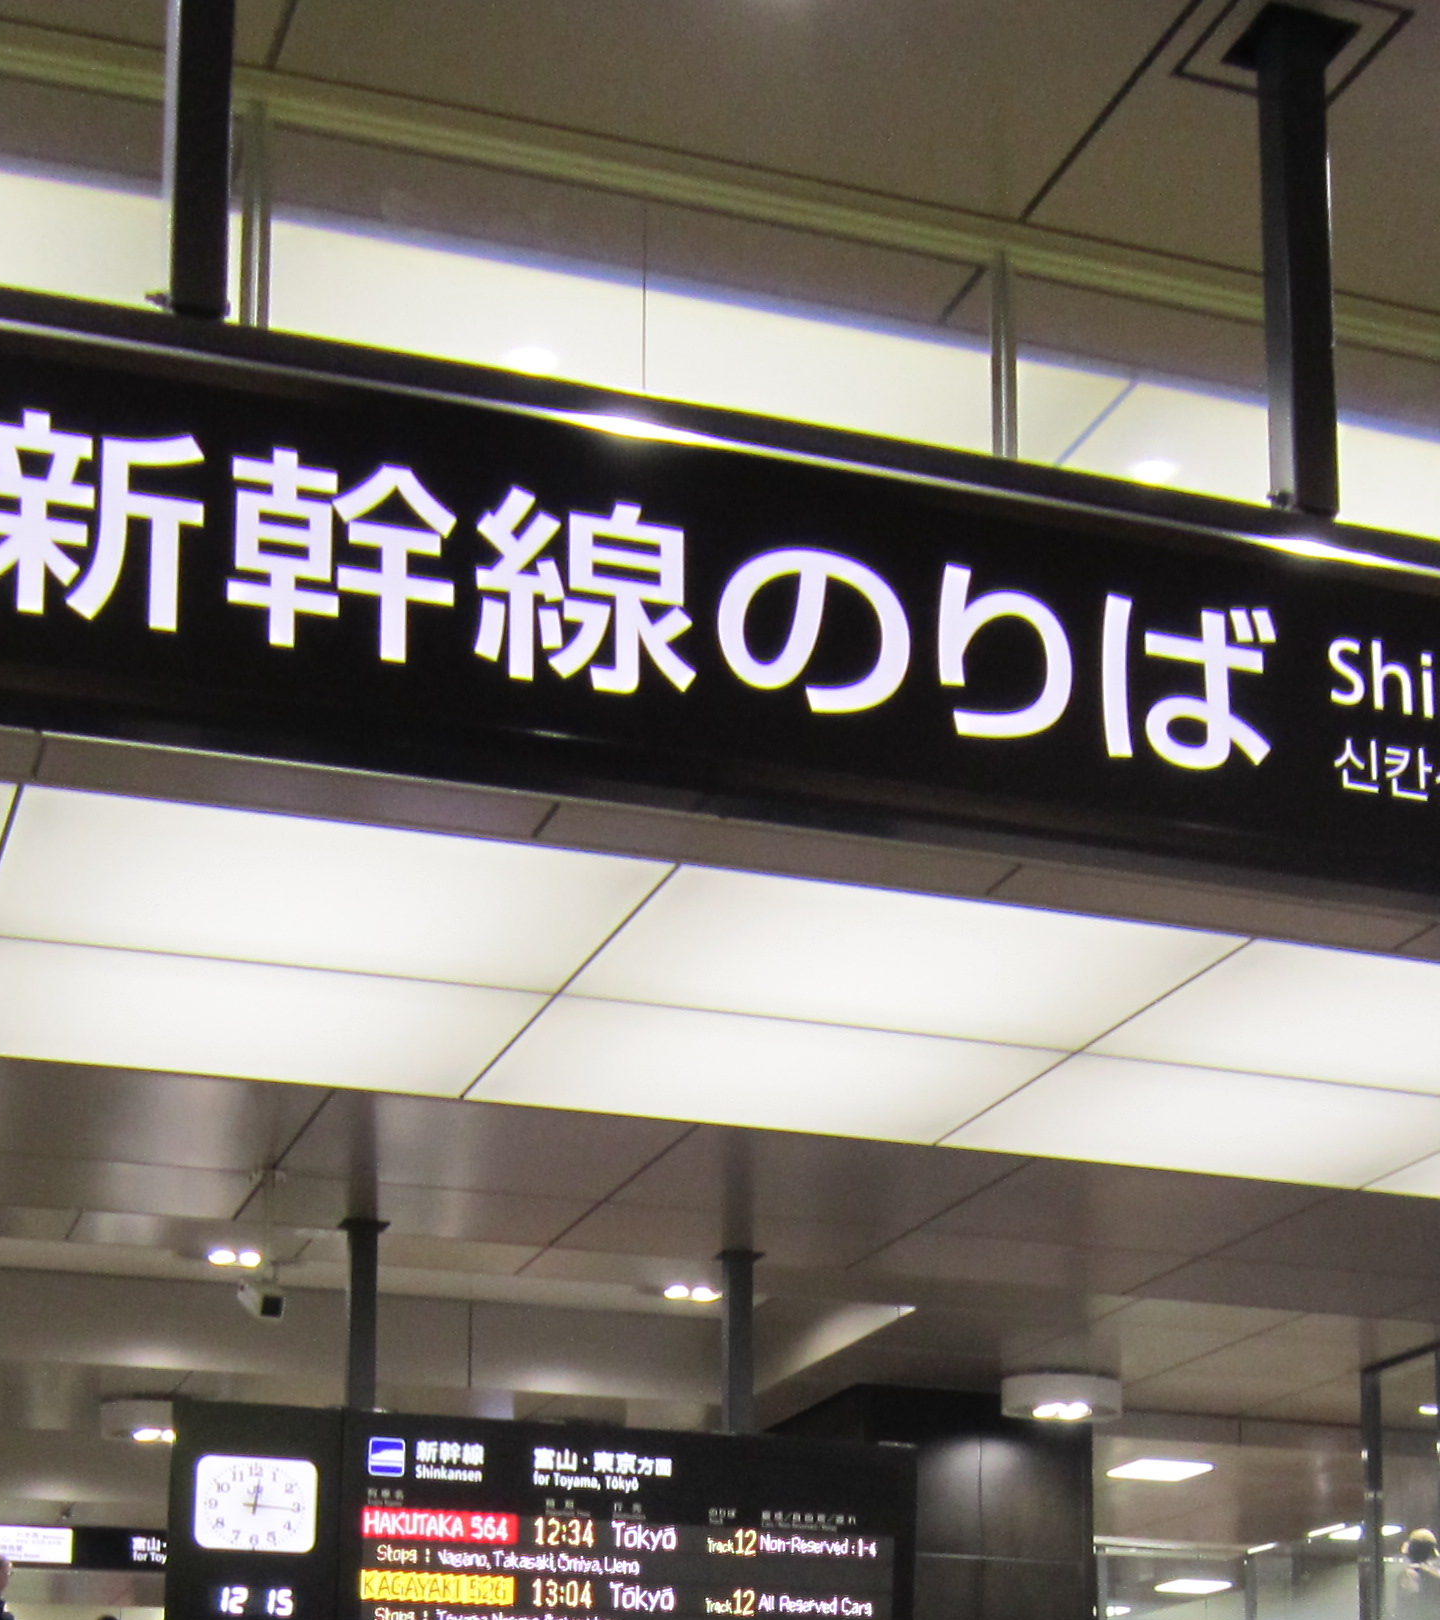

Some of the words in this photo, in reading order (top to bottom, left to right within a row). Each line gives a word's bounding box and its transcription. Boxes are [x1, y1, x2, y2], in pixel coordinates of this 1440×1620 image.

[415, 1440, 485, 1466] 新幹線
[415, 1465, 483, 1483] Shinkansen
[533, 1471, 550, 1486] for
[553, 1473, 602, 1491] Toyama,
[363, 1511, 464, 1539] HAKUTAKA
[470, 1516, 510, 1541] 564
[533, 1516, 596, 1548] 12:34
[707, 1538, 734, 1554] Track
[734, 1528, 757, 1556] 12
[220, 1586, 249, 1615] 12
[266, 1587, 295, 1617] 15
[362, 1570, 461, 1601] KAGAYAKI
[468, 1578, 507, 1602] 526
[532, 1578, 593, 1609] 13:04
[705, 1598, 732, 1614] Track
[732, 1588, 756, 1617] 12
[758, 1593, 775, 1611] All
[778, 1595, 838, 1615] Reserved
